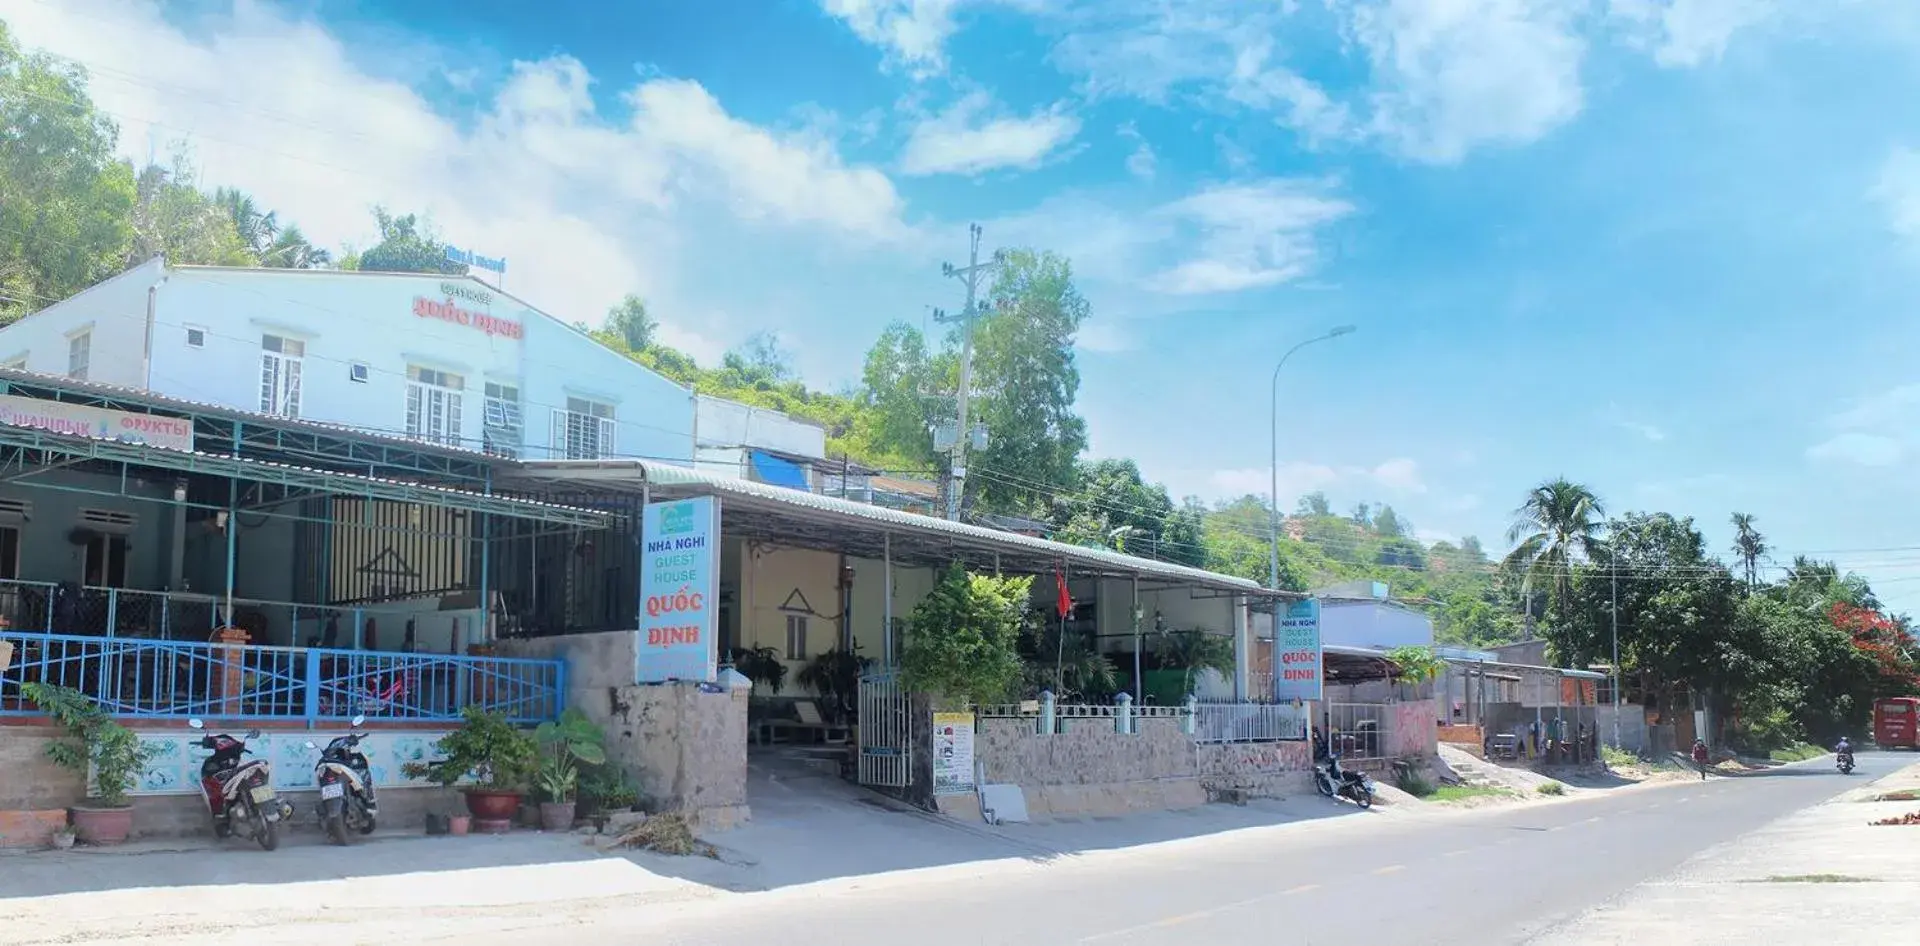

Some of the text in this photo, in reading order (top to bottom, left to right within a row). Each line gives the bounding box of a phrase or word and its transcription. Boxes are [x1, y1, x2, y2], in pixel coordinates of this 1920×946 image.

[120, 416, 188, 437] ФРУКТЫ
[656, 554, 696, 568] GUEST
[655, 570, 697, 584] HOUSE
[646, 584, 703, 617] QUỐC
[647, 626, 699, 649] ĐỊNH
[1282, 649, 1316, 664] QUỐC
[1283, 669, 1315, 681] ĐỊNH
